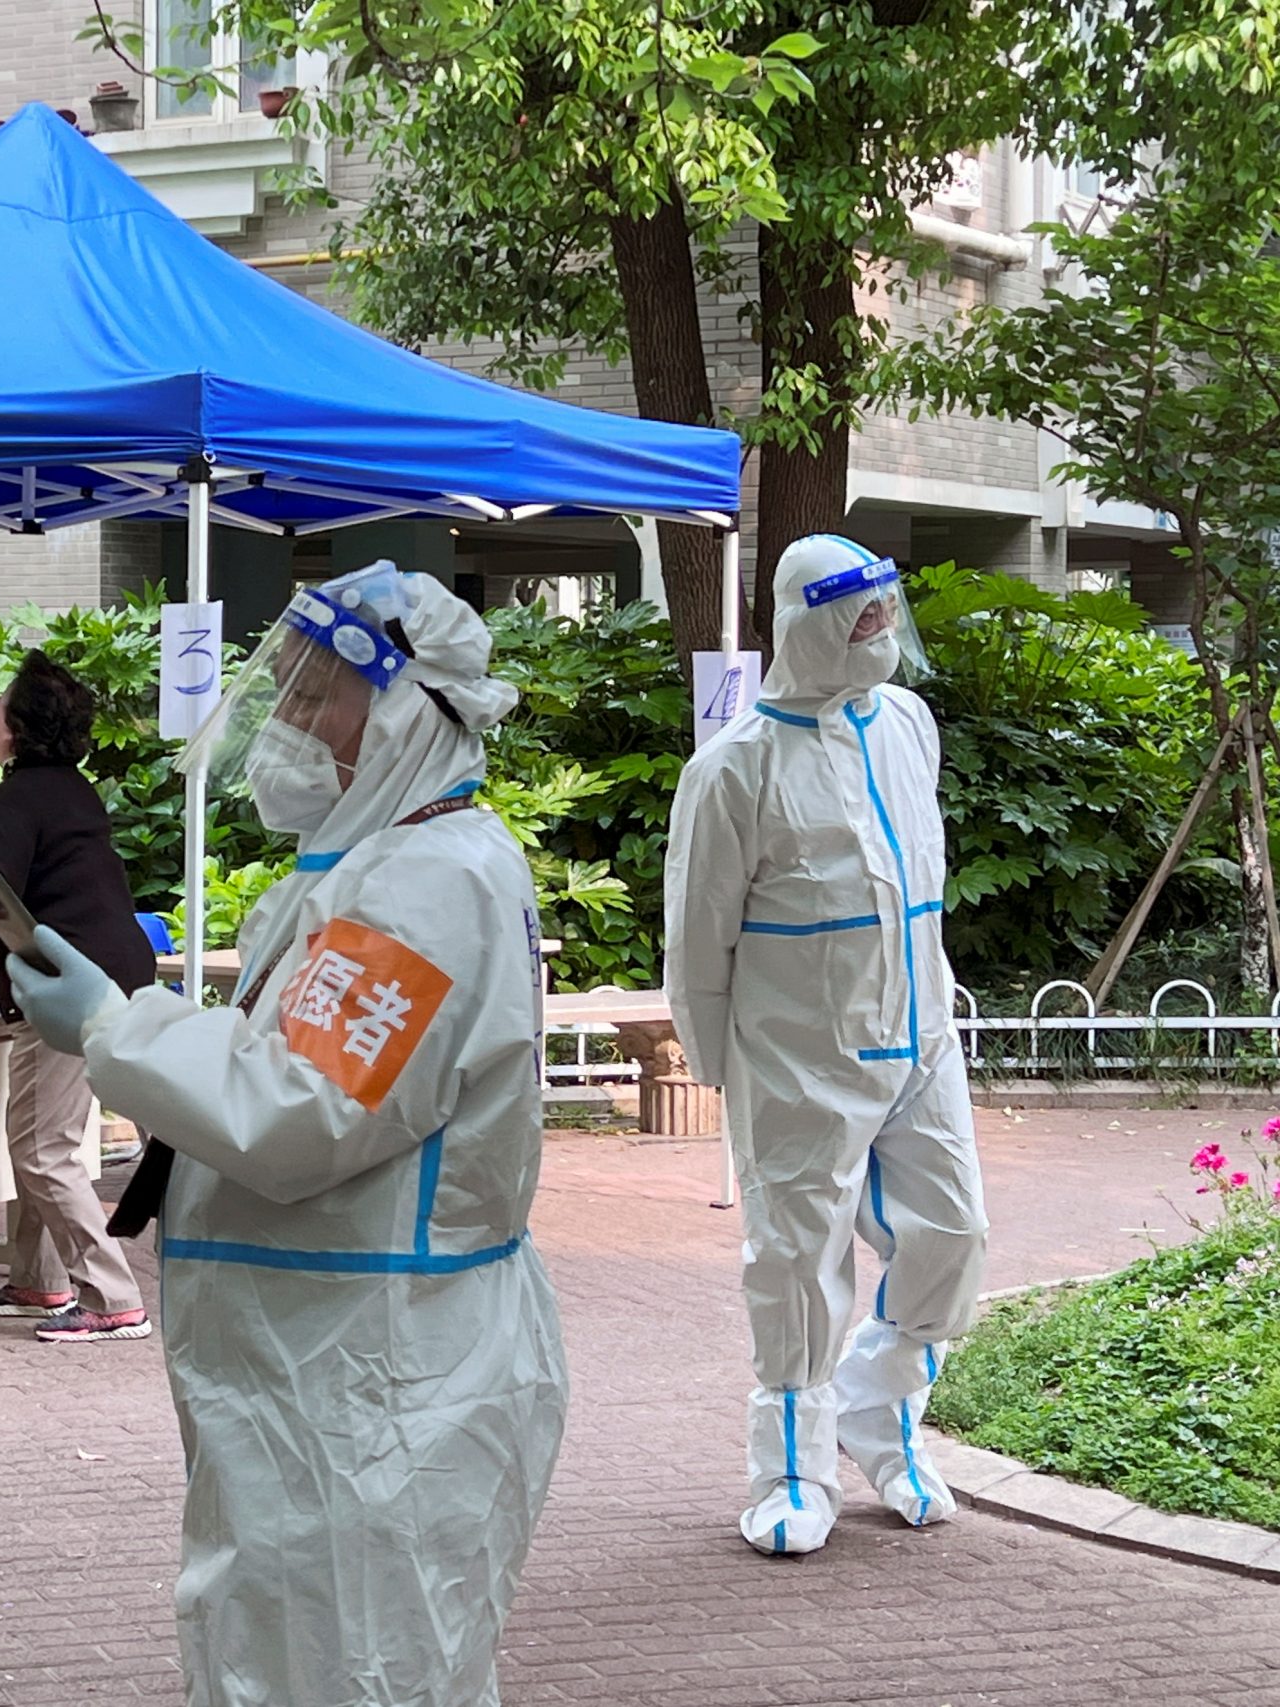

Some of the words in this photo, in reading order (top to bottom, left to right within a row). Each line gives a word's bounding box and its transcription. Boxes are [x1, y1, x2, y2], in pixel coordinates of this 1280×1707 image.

[173, 629, 215, 695] 3
[702, 666, 742, 728] 4
[280, 948, 413, 1067] 愿者
